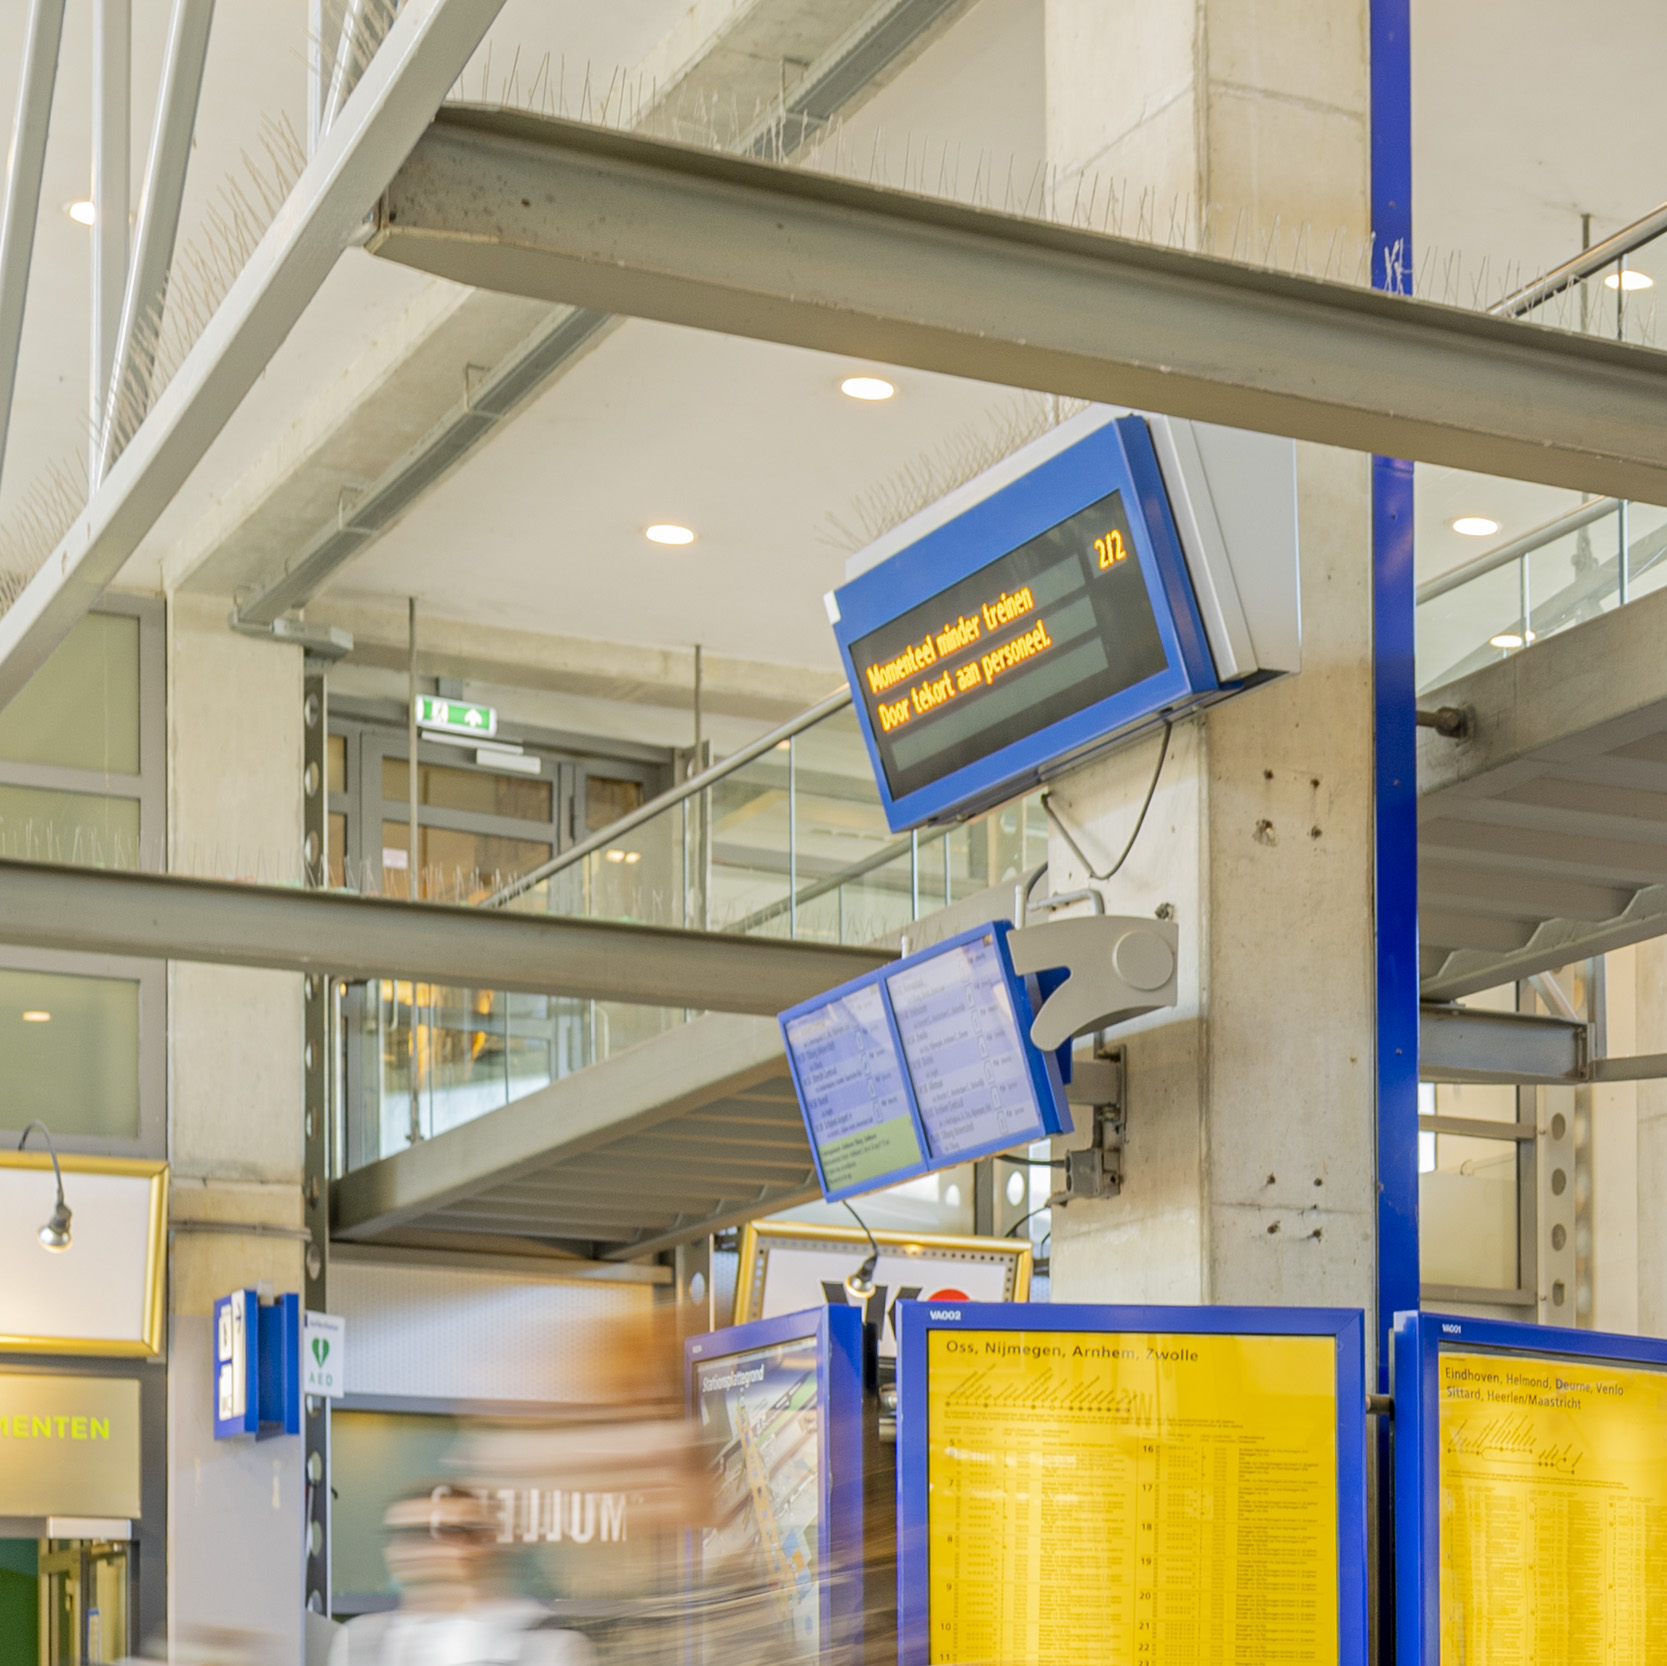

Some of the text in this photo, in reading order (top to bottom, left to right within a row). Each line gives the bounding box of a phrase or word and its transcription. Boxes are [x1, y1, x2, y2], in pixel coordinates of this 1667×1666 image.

[1094, 529, 1127, 570] 2/2
[866, 587, 1034, 694] Momenteel minder treinen
[878, 619, 1052, 732] Door tekort aan personeel.
[946, 1340, 1199, 1362] Oss, Nijmegen, Arnhem, Zwolle
[309, 1372, 333, 1386] AED
[1445, 1367, 1624, 1396] Eindhoven, Helmond, Deurne, Venlo
[1446, 1386, 1582, 1409] Sittard, Heerlen/Maastricht
